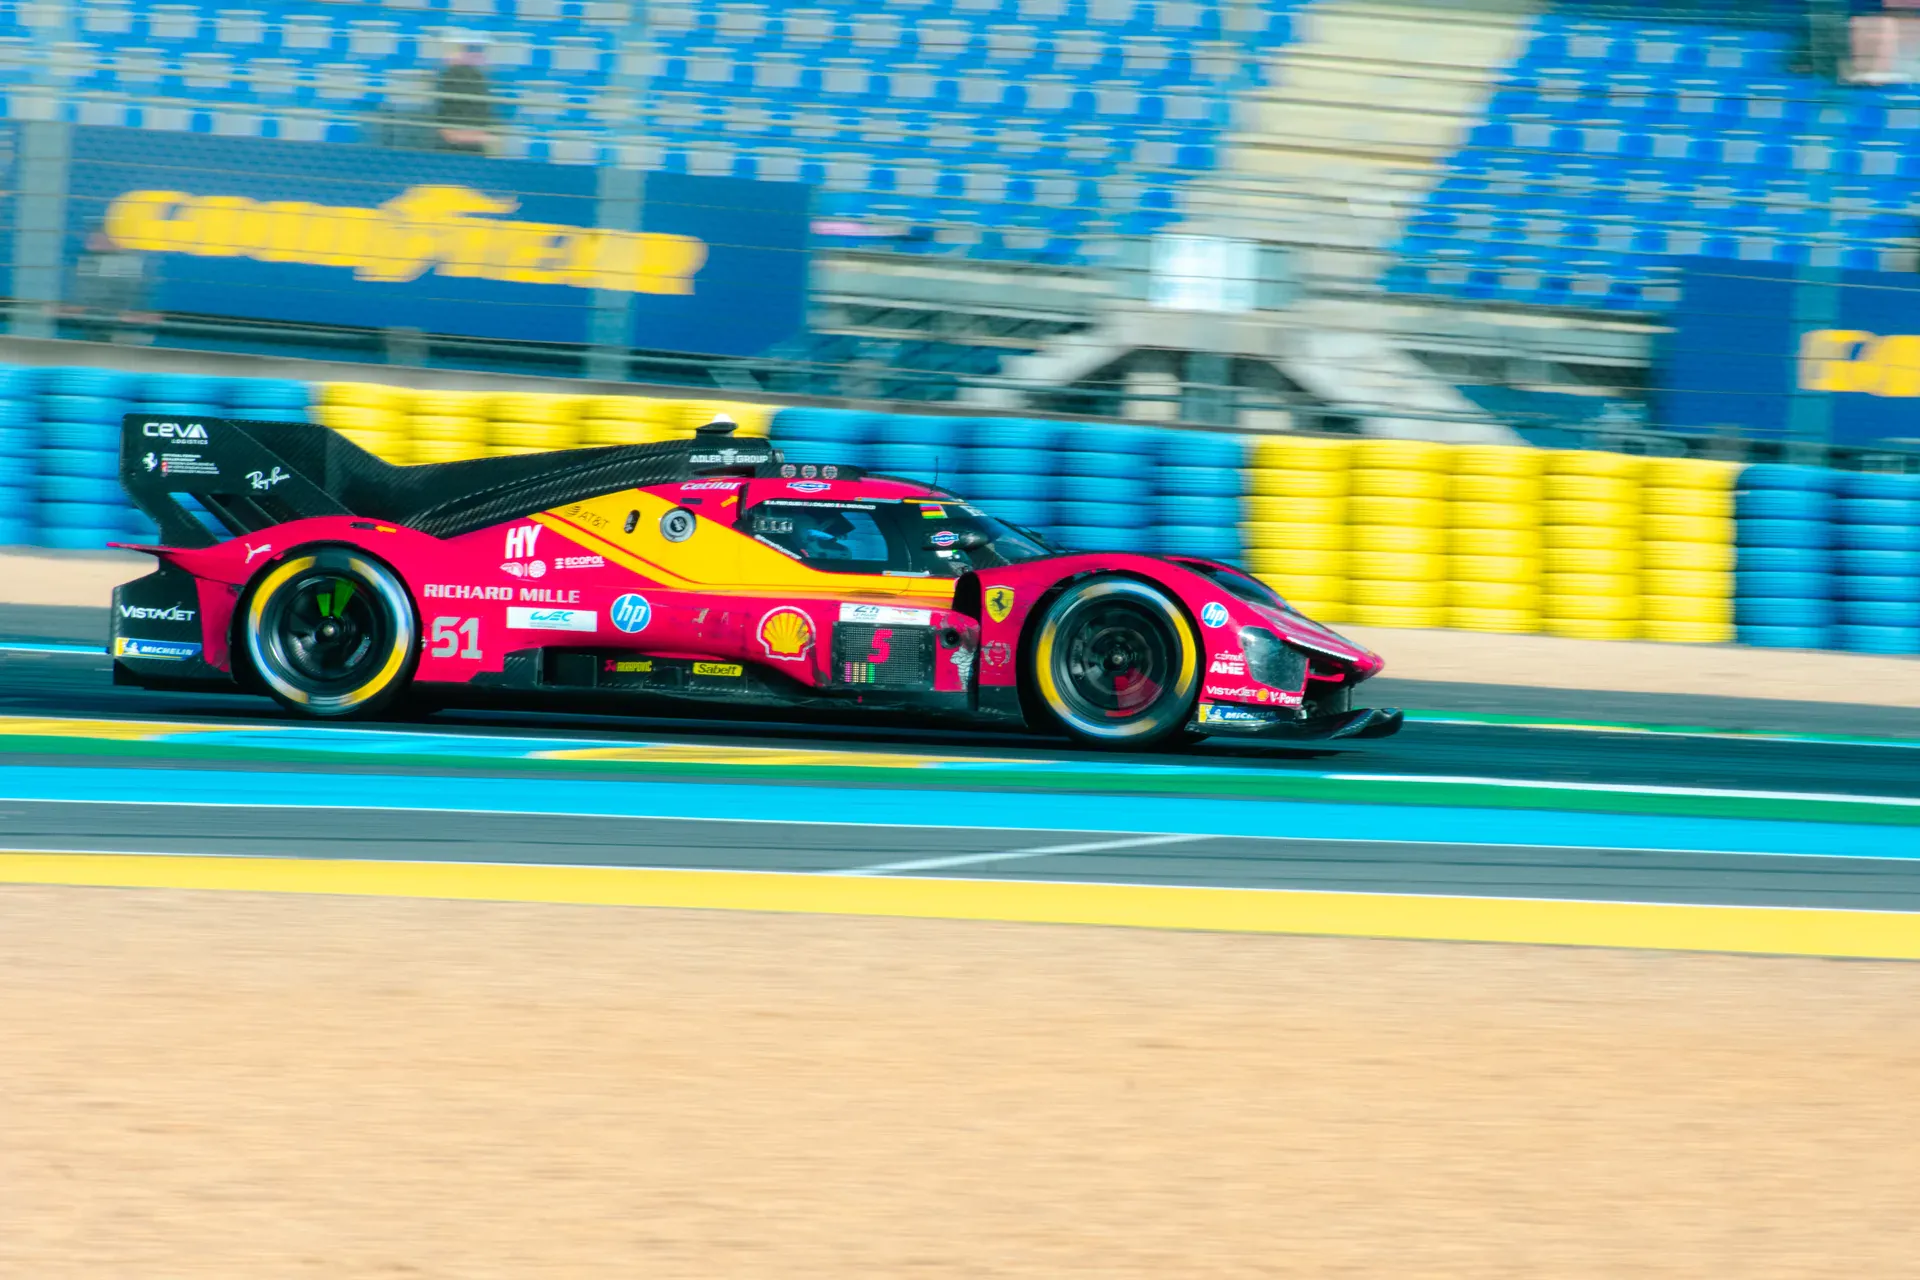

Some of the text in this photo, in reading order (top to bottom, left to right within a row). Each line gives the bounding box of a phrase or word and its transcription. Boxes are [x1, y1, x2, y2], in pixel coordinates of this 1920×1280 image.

[689, 454, 769, 463] ADLER GROUP
[579, 510, 609, 529] AT&T
[505, 524, 543, 559] HY
[565, 556, 605, 566] ECOPOL
[424, 584, 580, 603] RICHARD MILLE
[530, 611, 574, 622] WEC
[616, 594, 647, 632] hp
[1205, 603, 1226, 627] hp
[431, 616, 483, 659] 51
[867, 629, 893, 664] 5
[141, 645, 194, 656] MICHELIN
